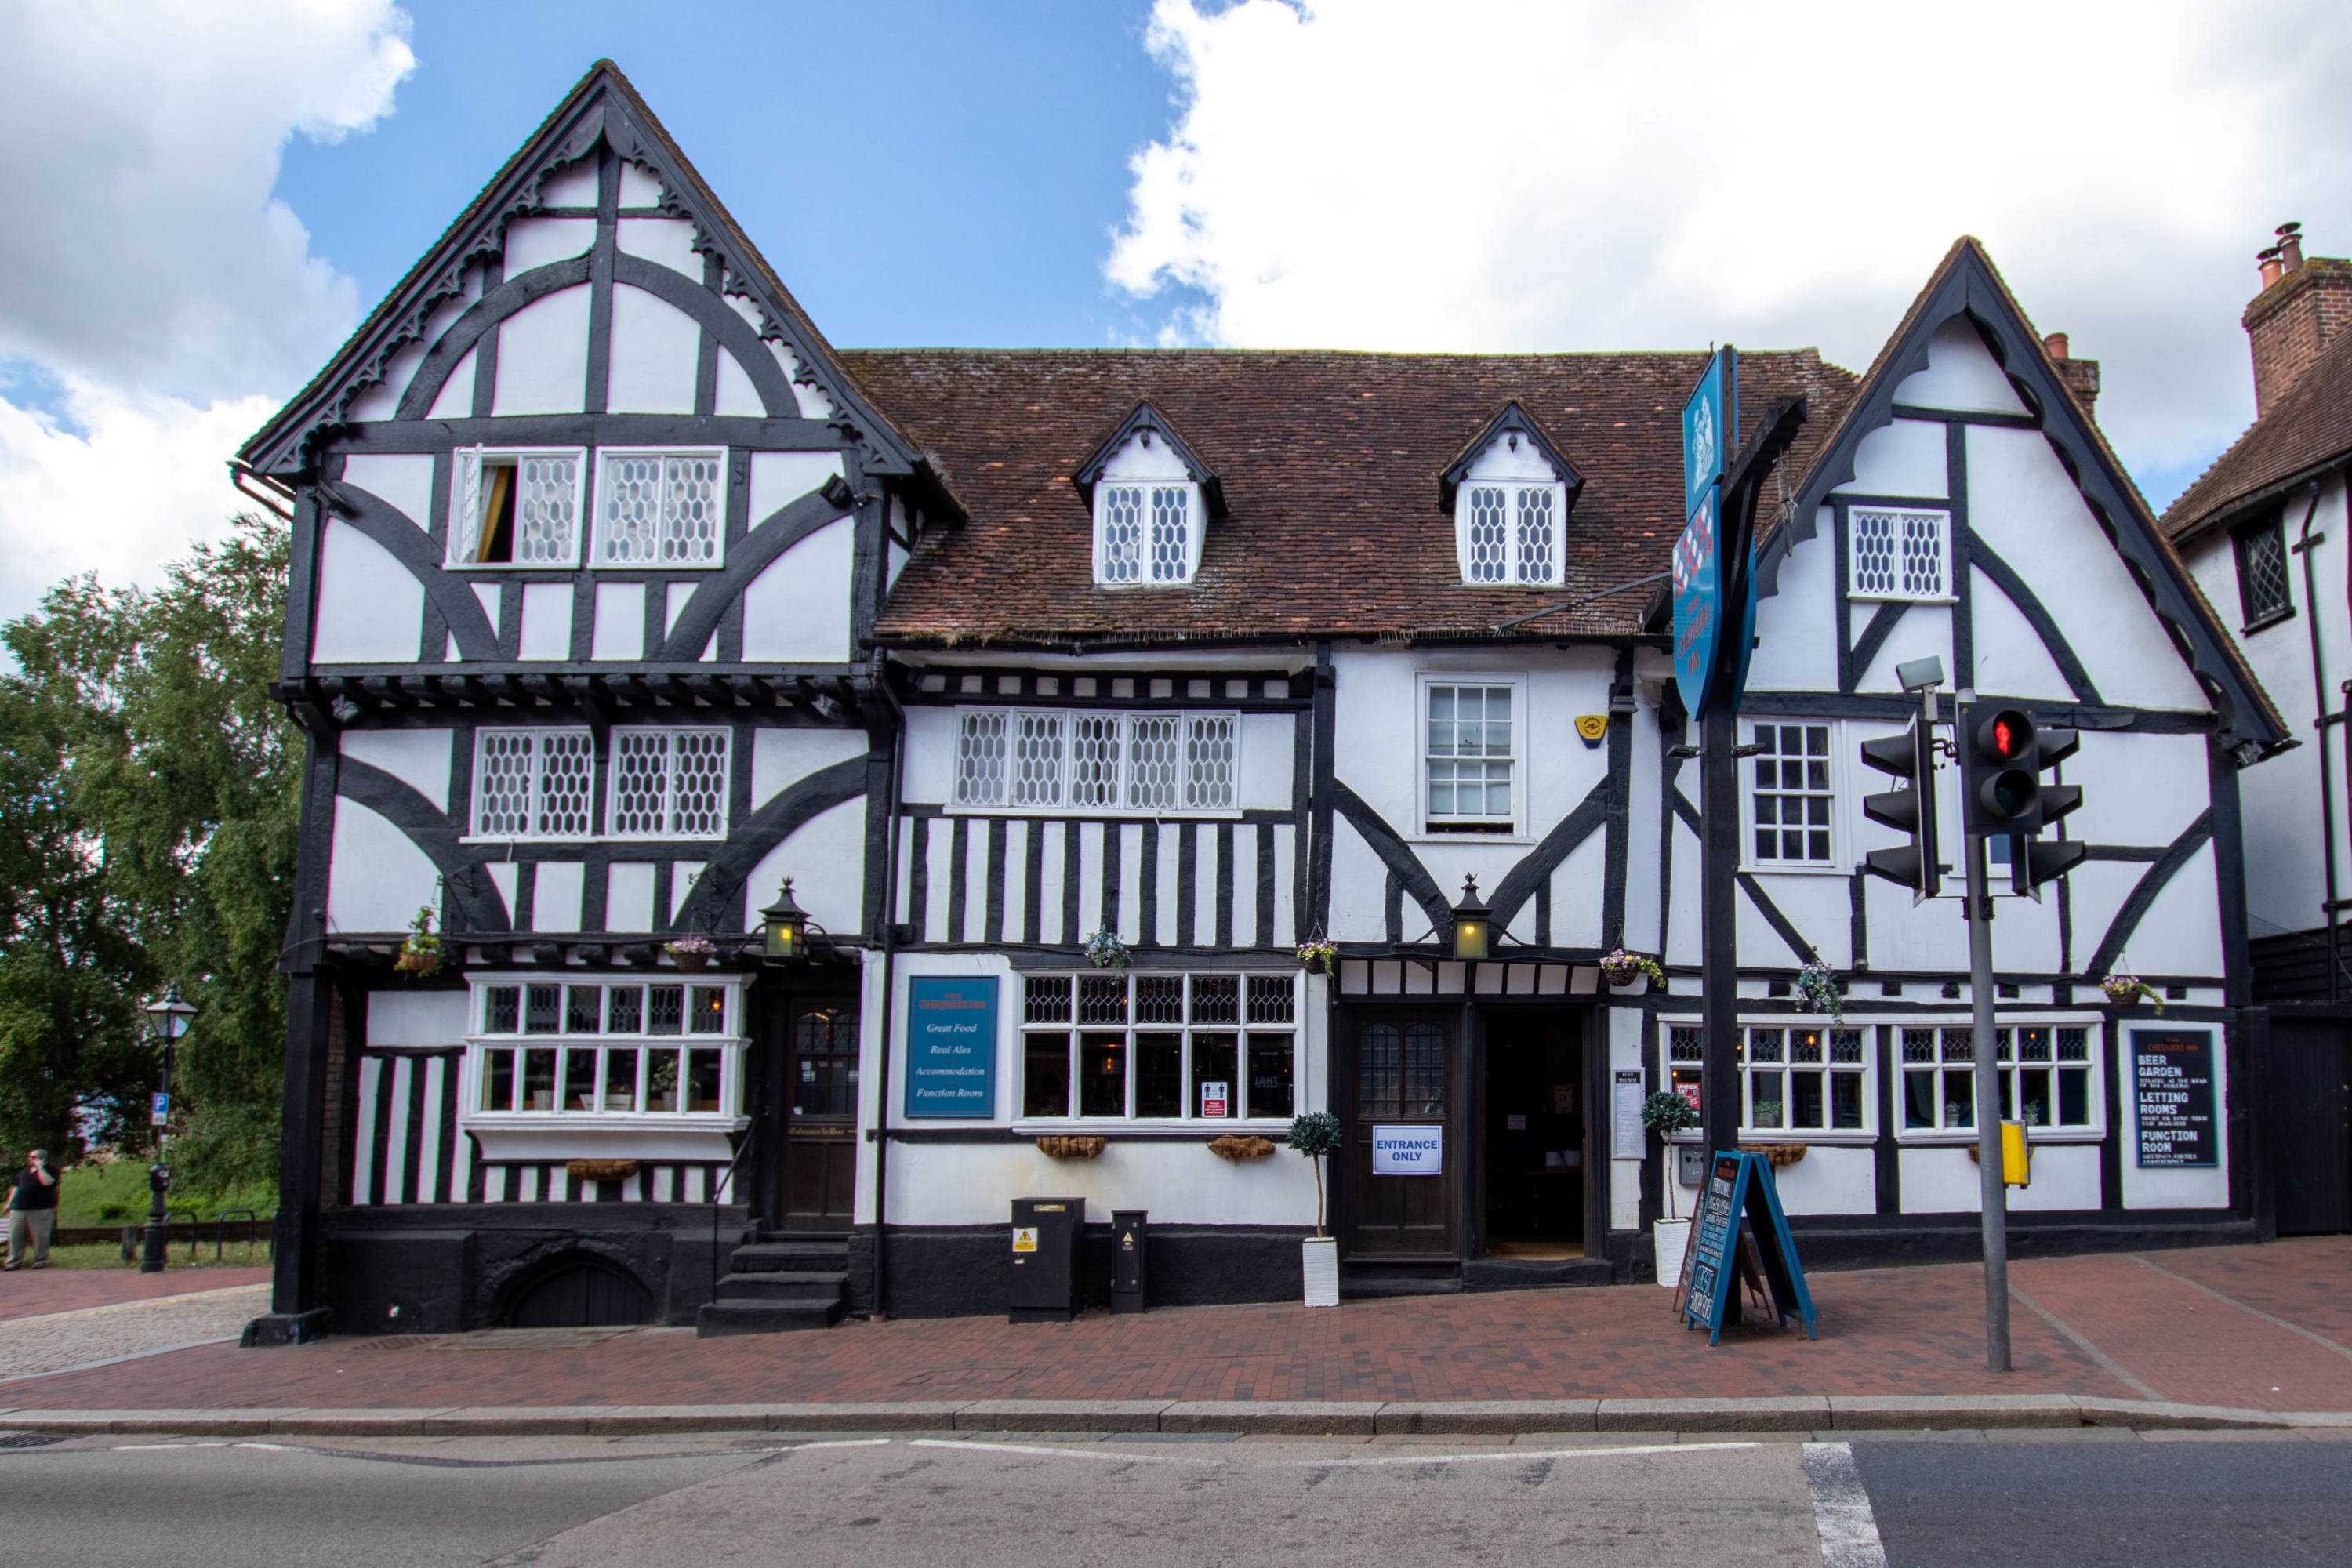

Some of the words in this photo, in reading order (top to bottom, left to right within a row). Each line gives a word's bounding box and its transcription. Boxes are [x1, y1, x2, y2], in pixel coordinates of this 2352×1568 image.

[1678, 601, 1711, 658] CHEQUERS
[1688, 649, 1699, 677] INN
[927, 1024, 952, 1033] Great
[953, 1024, 977, 1033] Food
[931, 1045, 951, 1054] Real
[952, 1045, 971, 1054] Ales
[2138, 1054, 2167, 1065] BEER
[916, 1067, 985, 1076] Accommodation
[2139, 1067, 2183, 1076] GARDEN
[916, 1088, 956, 1097] Function
[957, 1088, 983, 1097] Room
[2140, 1092, 2189, 1102] LETTING
[157, 1096, 165, 1110] P
[2140, 1105, 2178, 1114] ROOMS
[2142, 1131, 2198, 1141] FUNCTION
[1377, 1140, 1438, 1149] ENTRANCE
[2142, 1142, 2172, 1152] ROOM
[1392, 1152, 1422, 1161] ONLY
